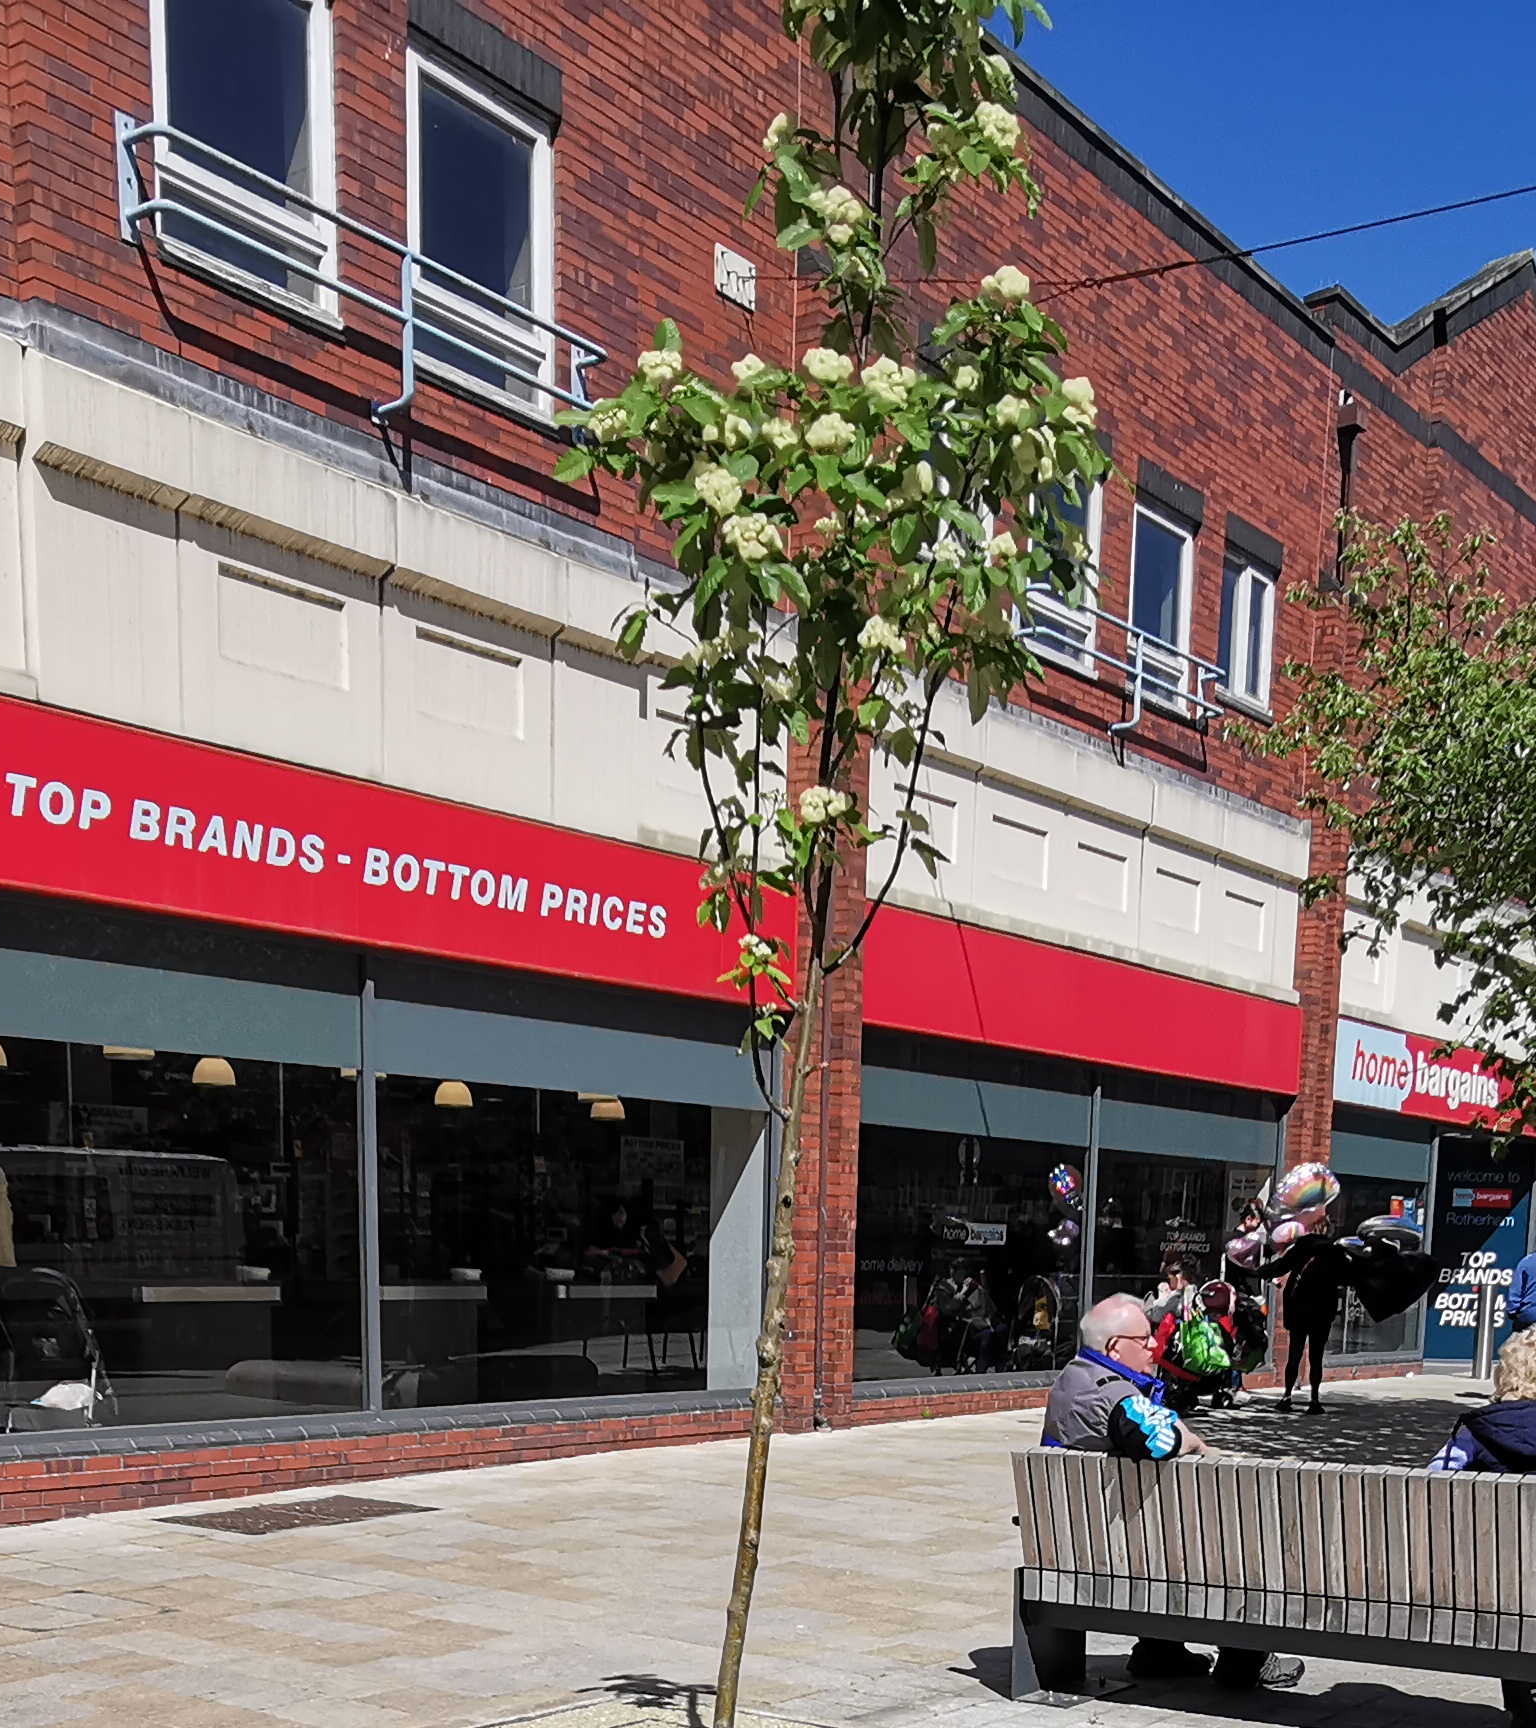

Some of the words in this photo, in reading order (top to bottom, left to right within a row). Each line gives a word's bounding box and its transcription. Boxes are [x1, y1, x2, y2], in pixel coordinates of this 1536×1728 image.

[5, 771, 113, 830] TOP
[128, 798, 325, 874] BRANDS
[362, 846, 529, 913] BOTTOM
[539, 881, 668, 939] PRICES
[1351, 1038, 1409, 1090] home
[1414, 1050, 1500, 1110] bargains
[1447, 1170, 1504, 1183] welcome
[1507, 1170, 1521, 1184] to
[1445, 1211, 1515, 1229] Rotherham
[943, 1225, 967, 1240] home
[1460, 1251, 1496, 1268] TOP
[1438, 1267, 1513, 1286] BRANDS
[1434, 1293, 1507, 1310] BOTTM
[1439, 1310, 1505, 1327] PRICS
